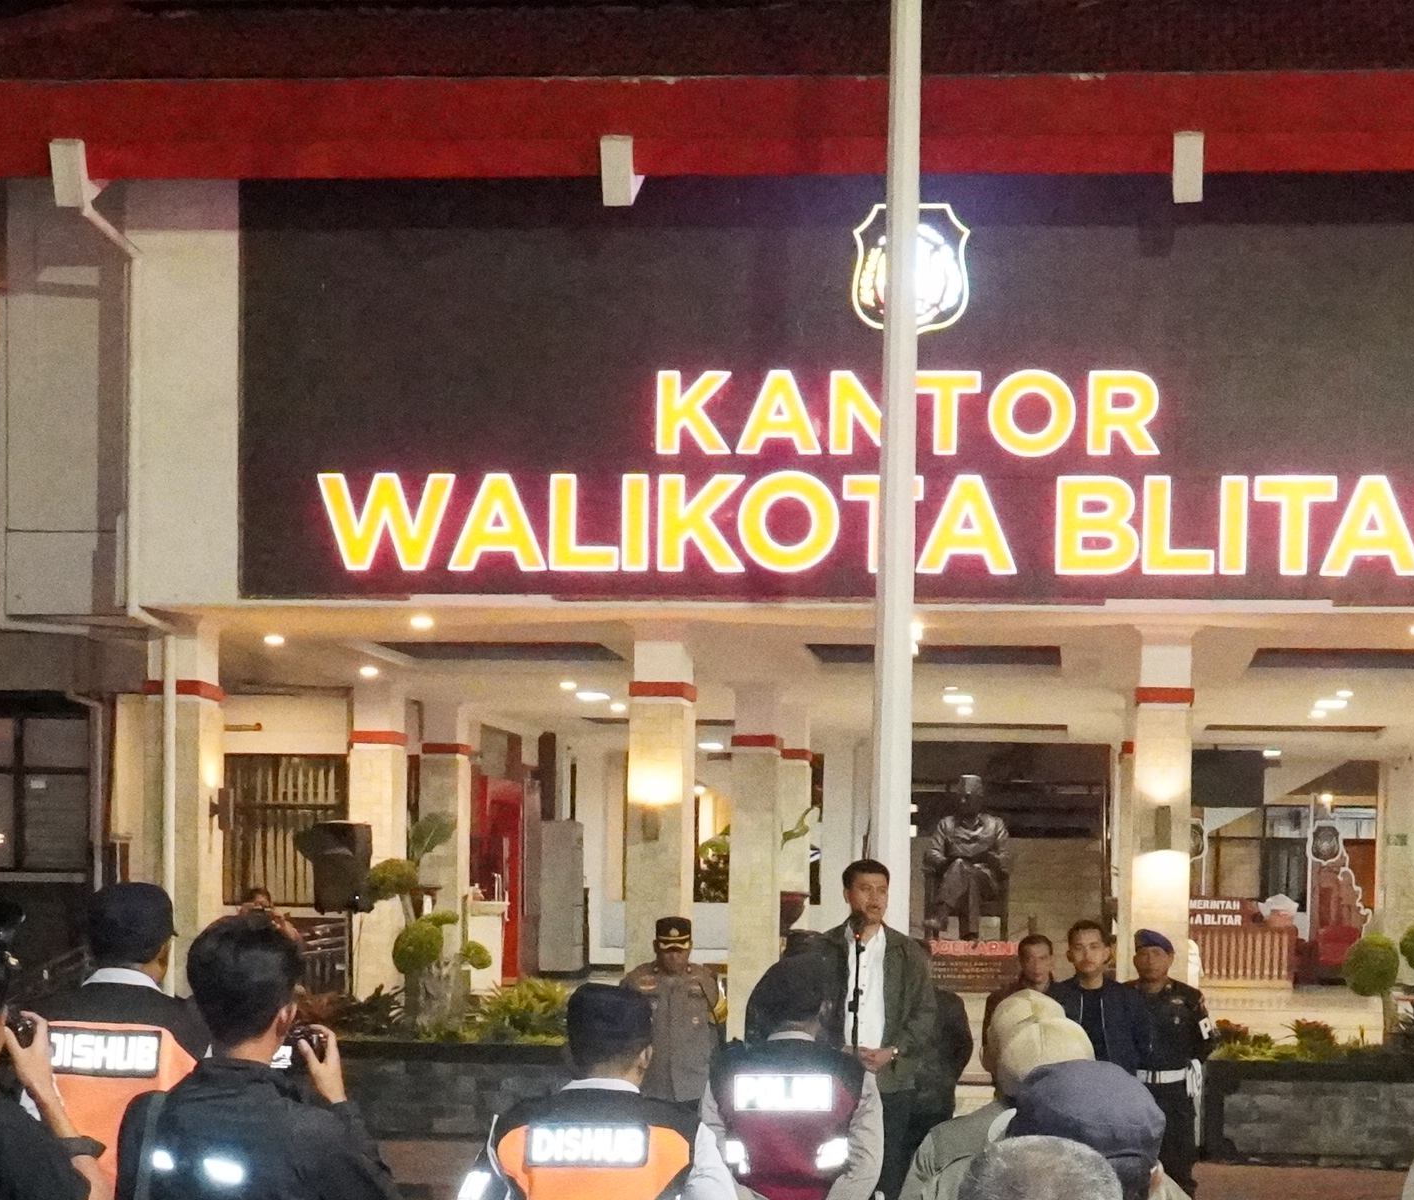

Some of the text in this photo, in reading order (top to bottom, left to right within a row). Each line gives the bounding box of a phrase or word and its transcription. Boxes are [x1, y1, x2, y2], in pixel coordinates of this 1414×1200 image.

[656, 368, 1160, 458] KANTOR
[317, 470, 1018, 575] WALIKOTA
[1204, 914, 1243, 926] BLITAR
[928, 940, 1019, 956] SOEKARN
[531, 1128, 645, 1163] DISHUB
